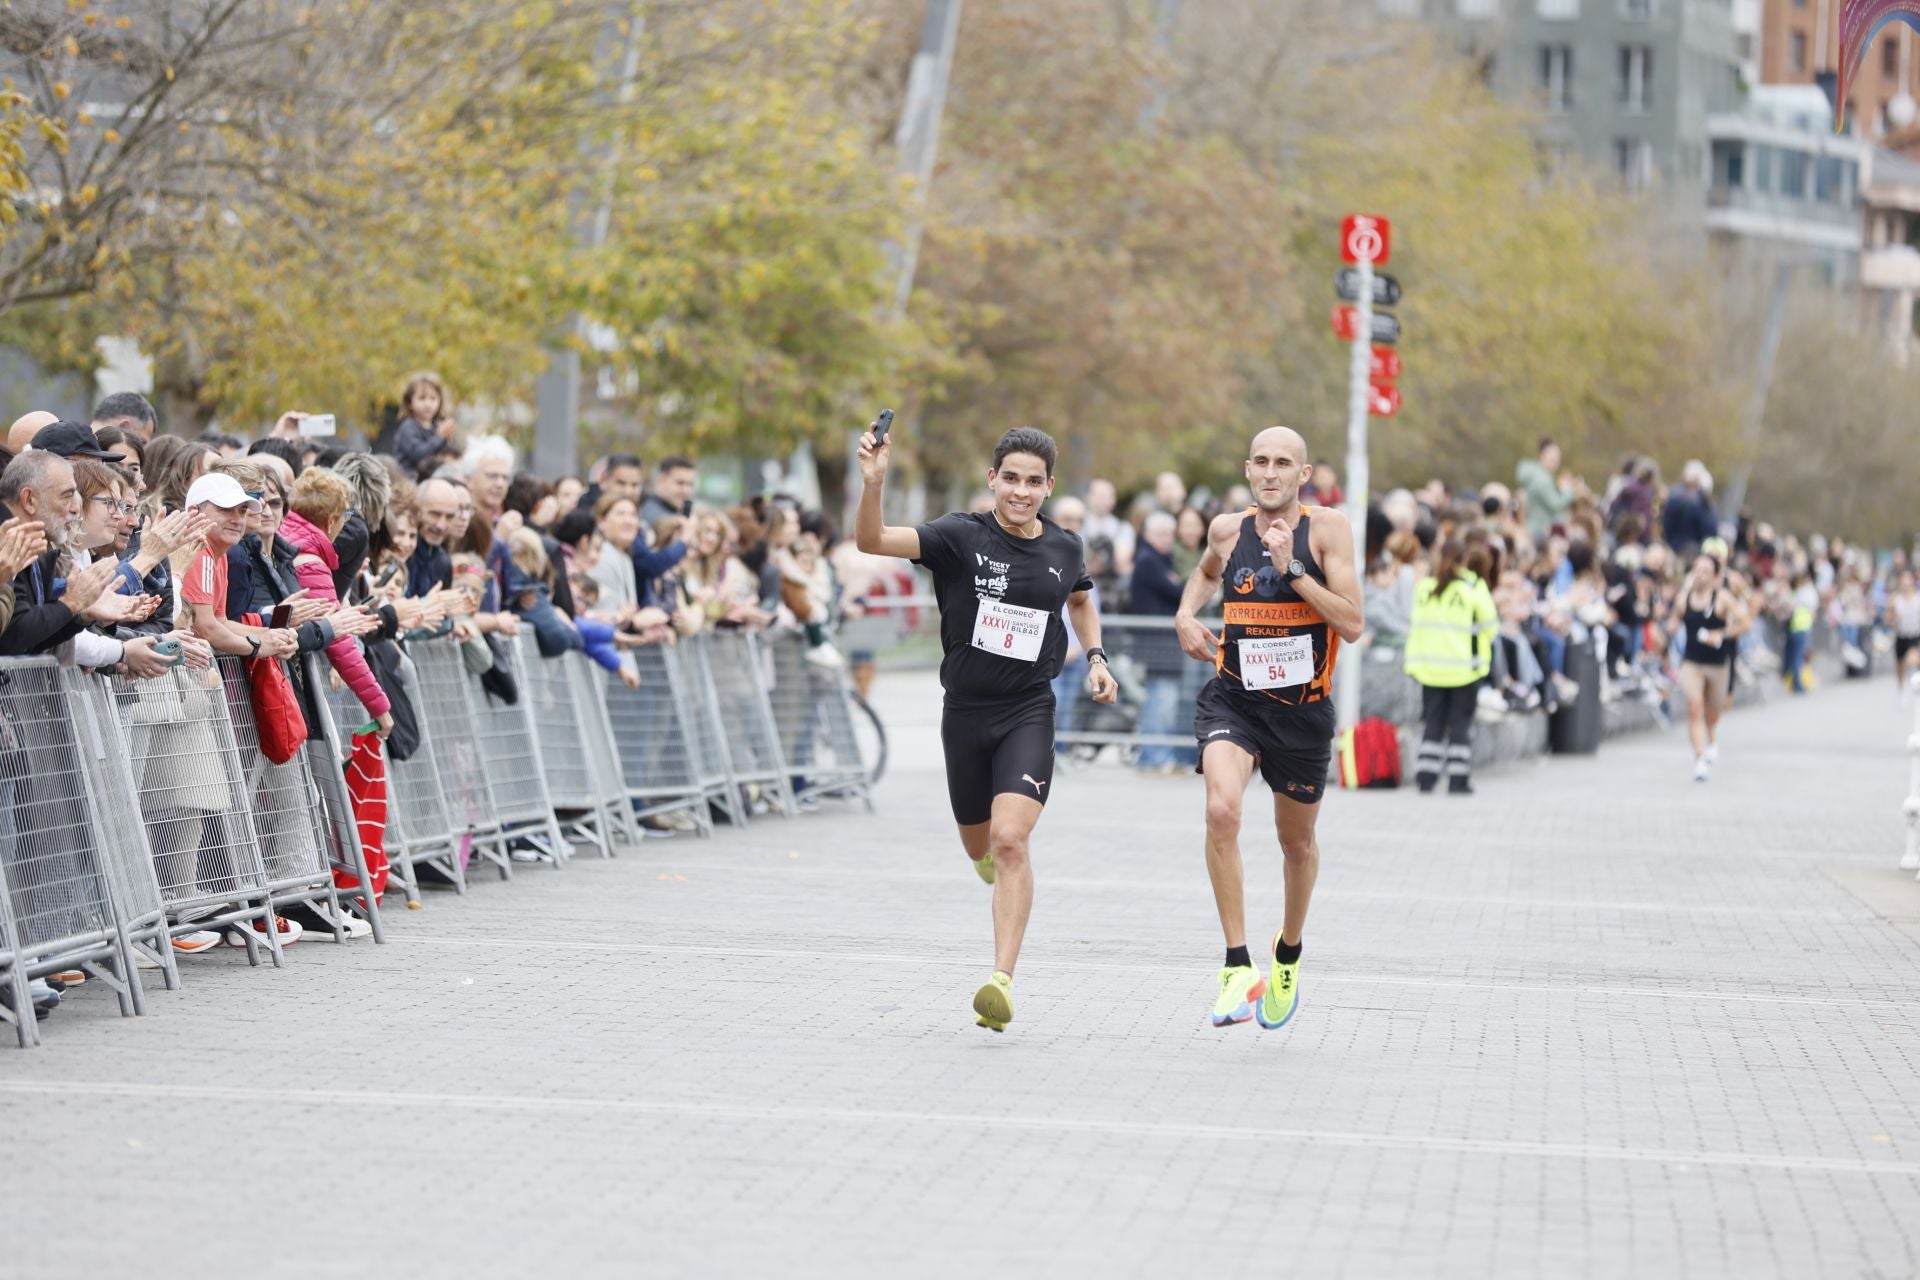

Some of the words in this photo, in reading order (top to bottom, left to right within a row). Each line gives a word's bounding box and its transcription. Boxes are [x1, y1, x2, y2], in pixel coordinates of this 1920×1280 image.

[989, 560, 1010, 569] VICKY
[975, 575, 987, 586] be
[1003, 608, 1034, 618] CORREO
[1011, 626, 1039, 635] BILBAO
[1246, 627, 1290, 637] REKALDE
[1004, 633, 1013, 649] 8
[1275, 655, 1305, 663] BILBAO
[1268, 666, 1286, 680] 54
